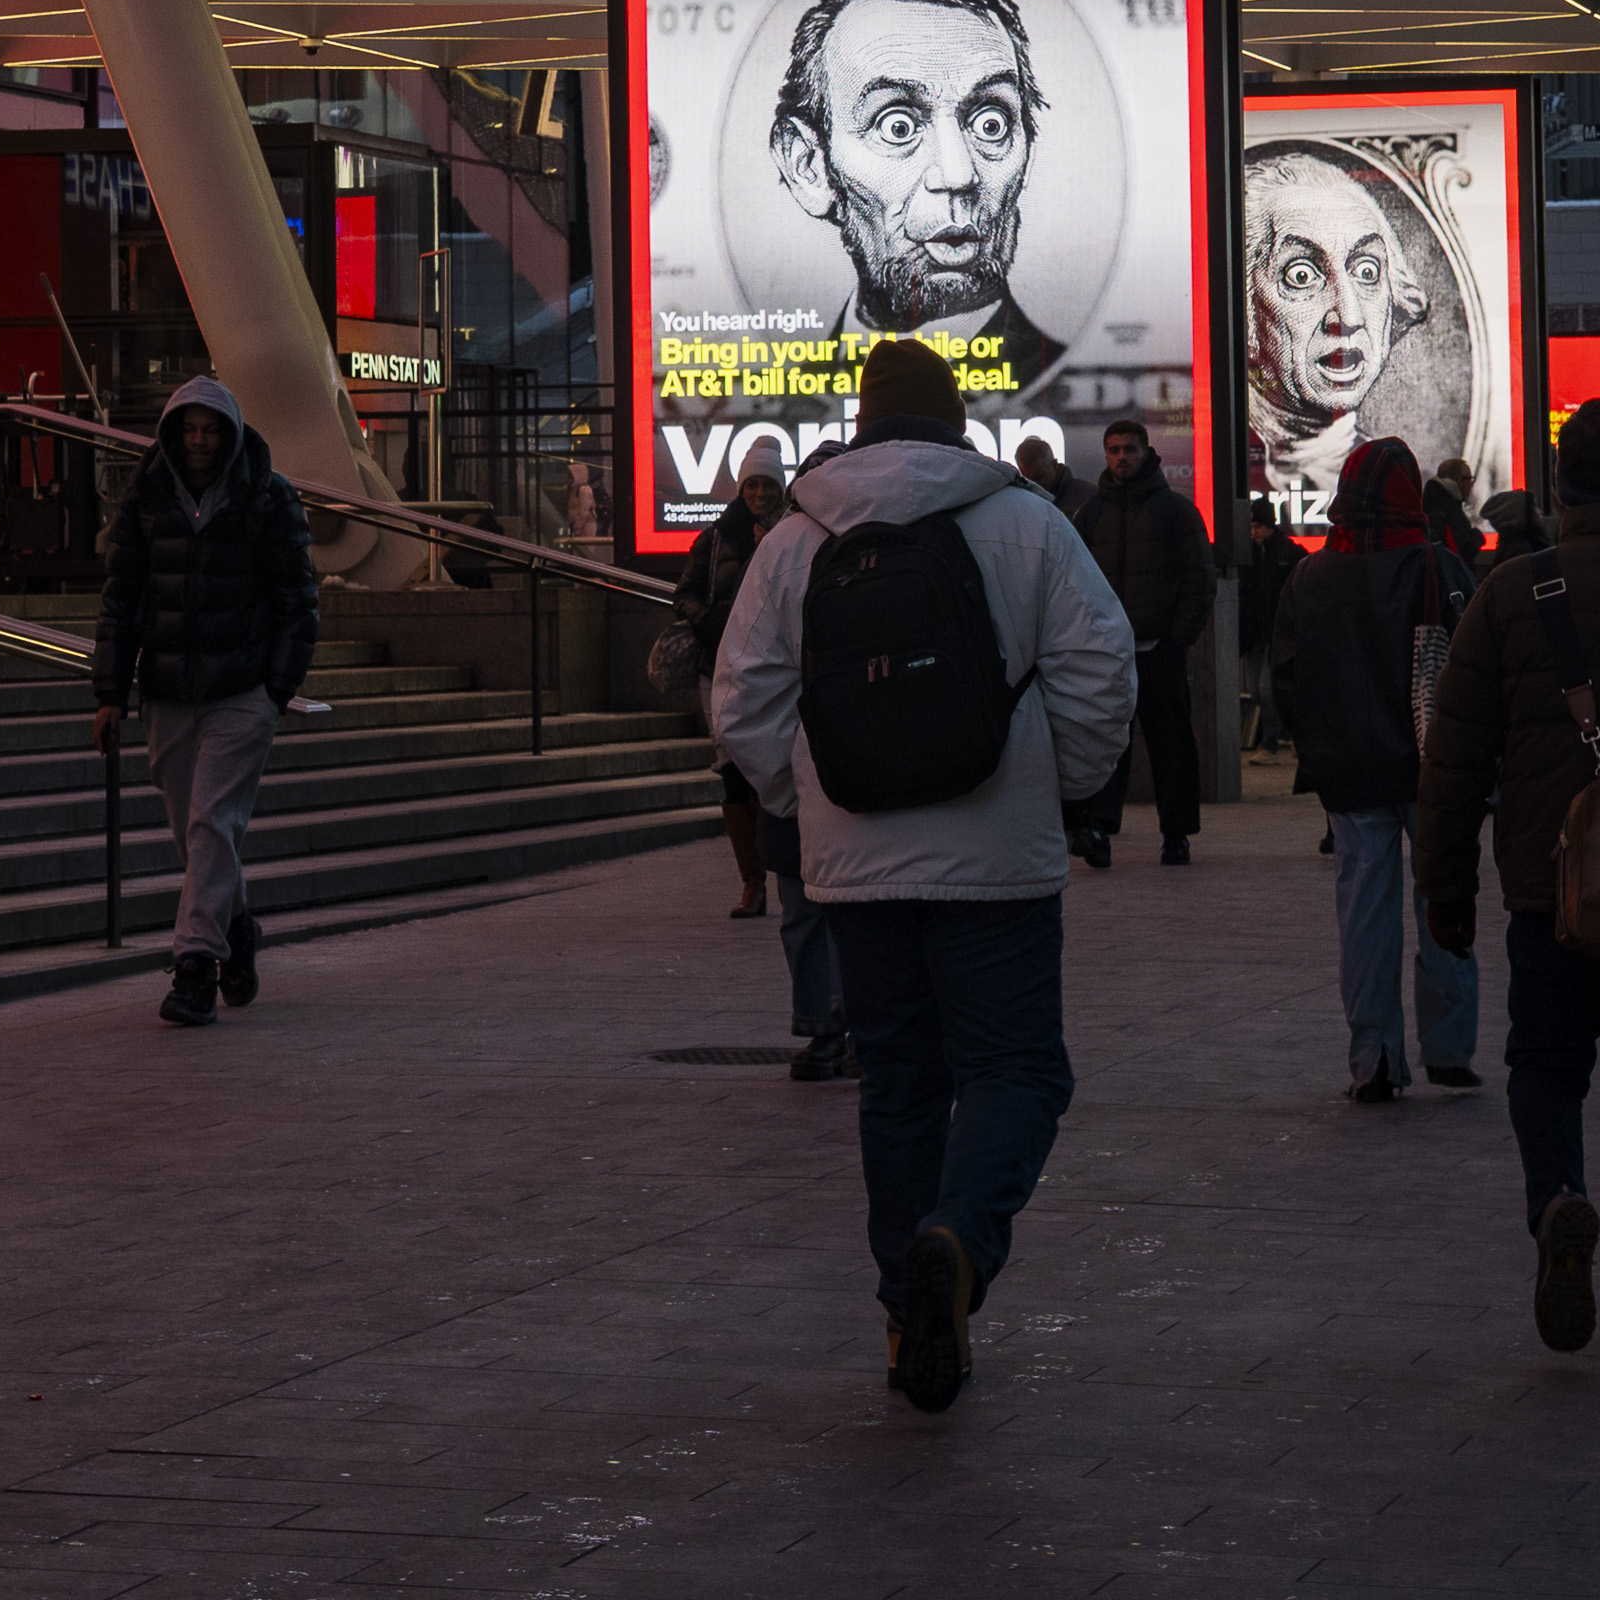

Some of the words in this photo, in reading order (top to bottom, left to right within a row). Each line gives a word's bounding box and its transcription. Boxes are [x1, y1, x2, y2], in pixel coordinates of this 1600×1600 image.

[659, 311, 700, 333] You
[703, 309, 766, 331] heard
[768, 308, 824, 333] right.
[660, 337, 738, 369] Bring
[742, 336, 768, 363] in
[771, 340, 838, 367] your
[840, 331, 968, 361] T-ile
[970, 336, 1004, 359] or
[351, 351, 388, 380] PENN
[389, 354, 441, 385] STATON
[660, 369, 740, 398] AT&T
[743, 367, 785, 397] bill
[788, 367, 829, 396] for
[833, 373, 852, 395] a
[957, 362, 1019, 391] deal.
[661, 398, 1066, 495] vern
[664, 502, 703, 513] Postpaid
[704, 503, 727, 513] cons
[664, 512, 677, 522] 45
[678, 512, 699, 523] days
[700, 512, 716, 522] and
[1249, 479, 1334, 525] riz
